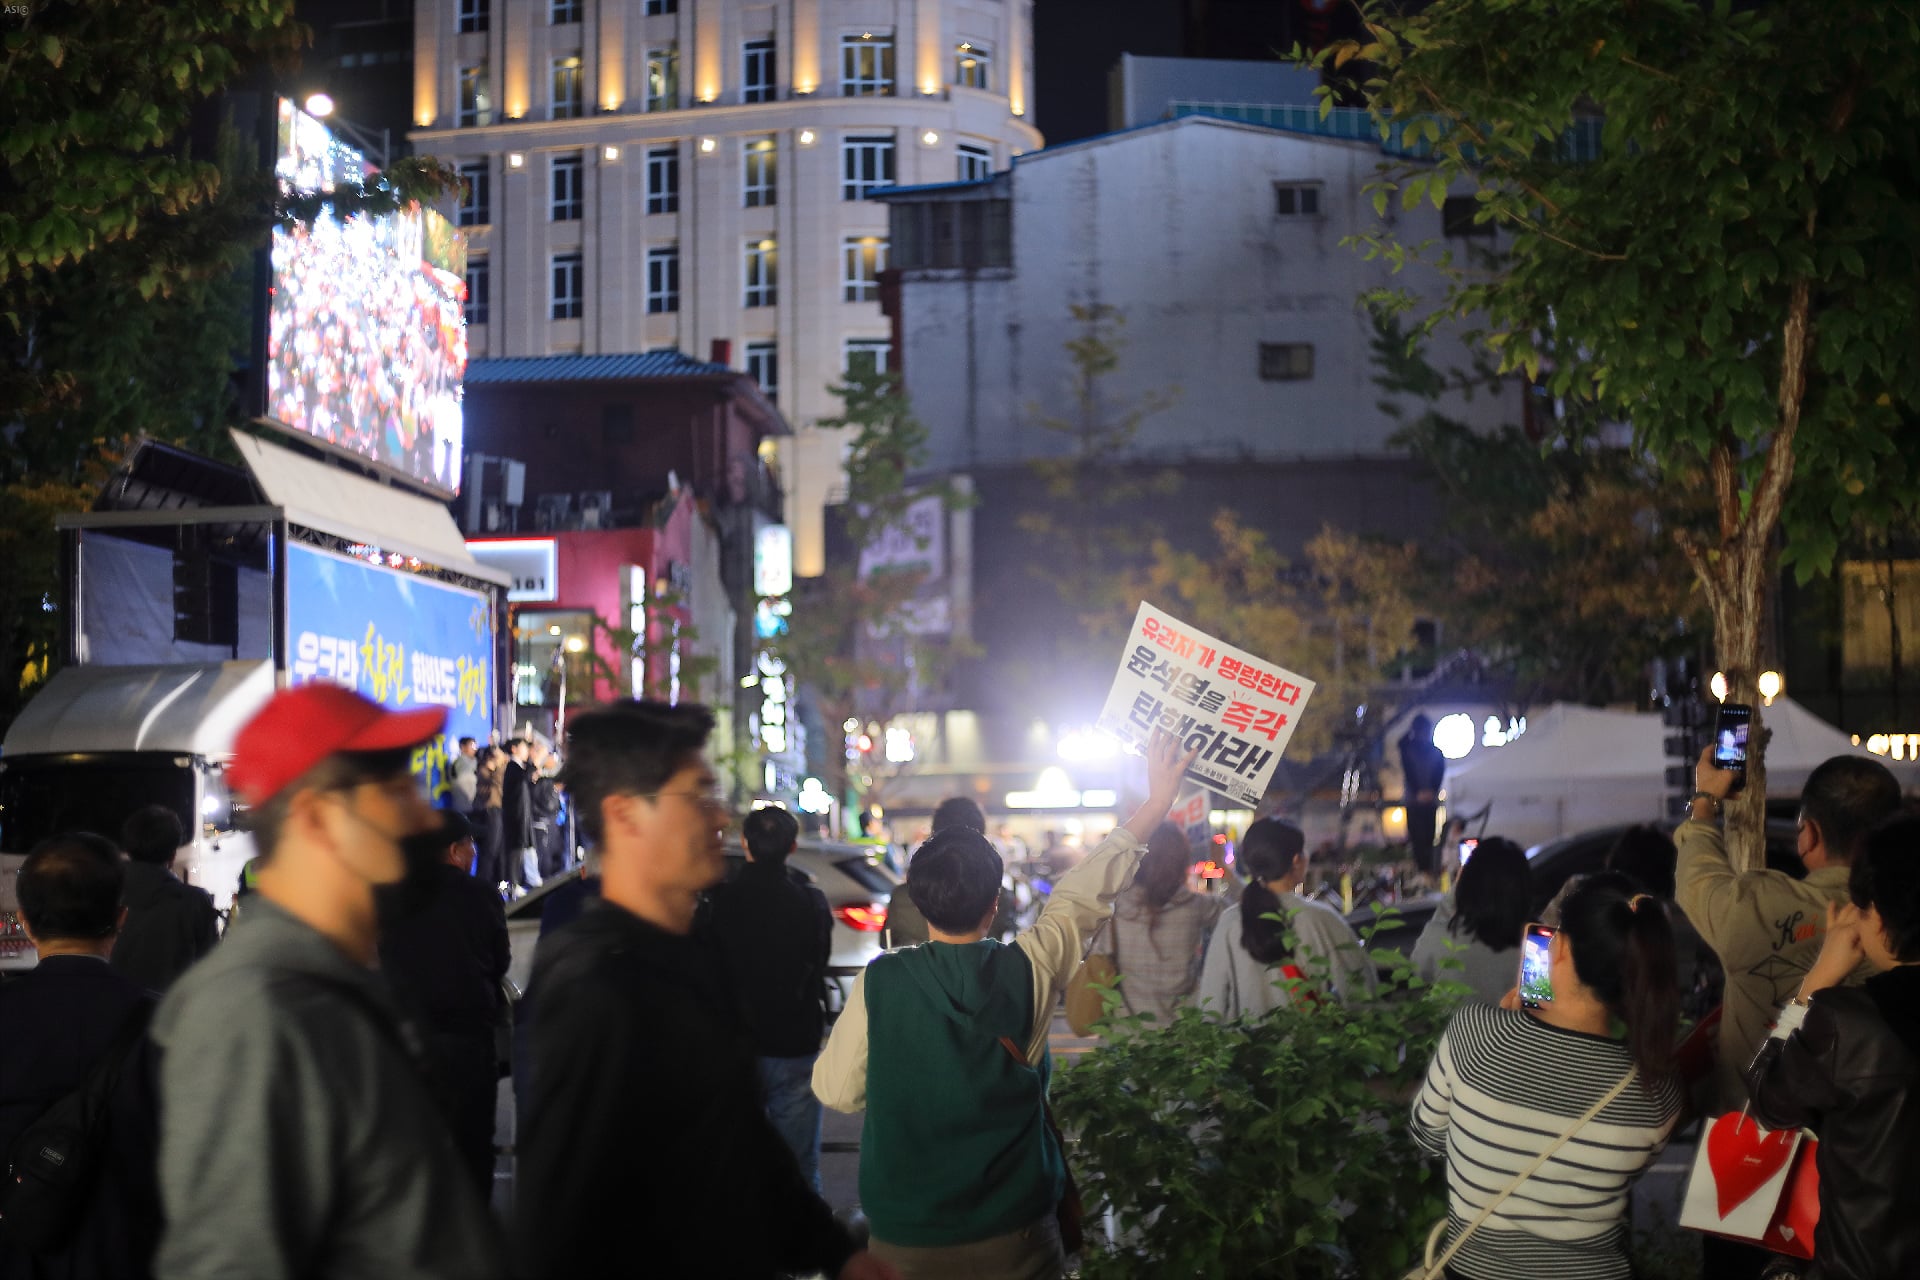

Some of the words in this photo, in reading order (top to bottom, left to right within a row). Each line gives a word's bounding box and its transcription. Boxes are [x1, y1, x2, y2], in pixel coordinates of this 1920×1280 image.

[294, 631, 359, 692] 우크라
[1127, 645, 1227, 714] 윤석열을
[1221, 699, 1289, 742] 즉각
[1142, 617, 1217, 669] 유권자가
[1217, 655, 1302, 707] 명령한다
